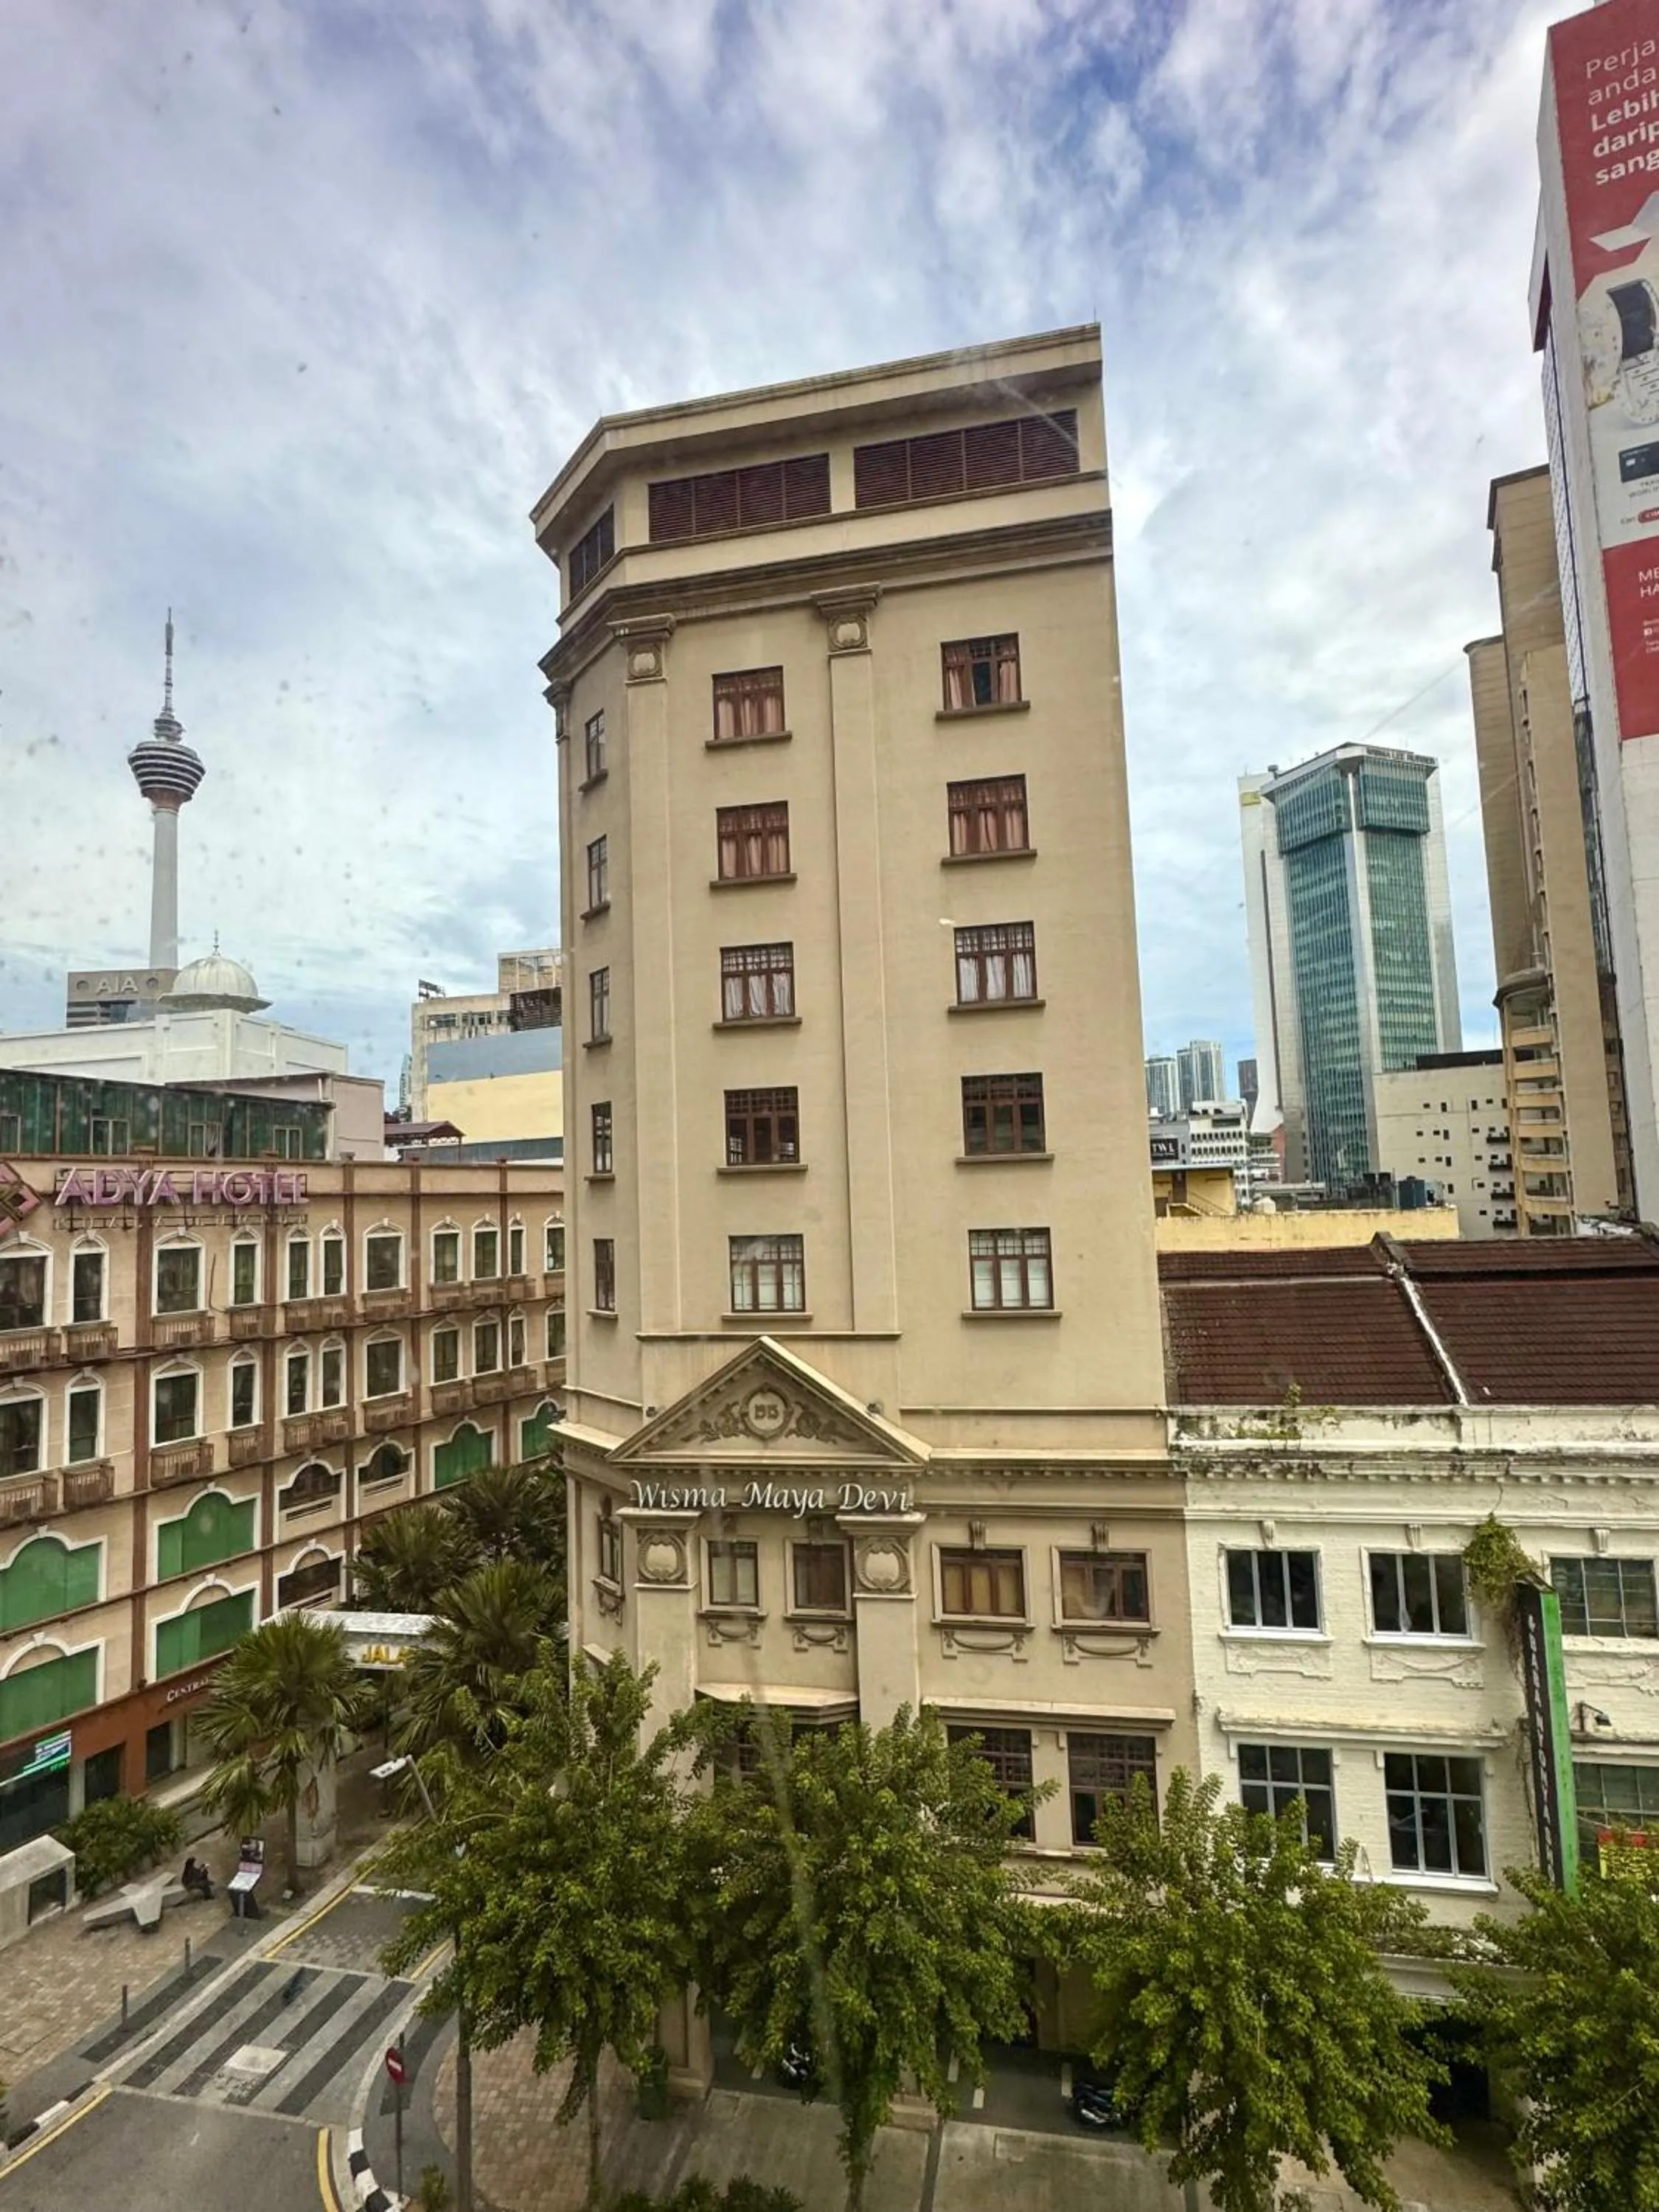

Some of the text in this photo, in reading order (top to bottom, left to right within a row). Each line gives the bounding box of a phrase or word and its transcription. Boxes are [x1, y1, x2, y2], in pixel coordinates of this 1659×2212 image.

[1586, 39, 1656, 80] Perja
[1587, 67, 1657, 105] anda
[97, 976, 138, 994] AIA
[55, 1169, 310, 1206] ADYA HOTEL
[630, 1479, 910, 1519] Wisma Maya Devi
